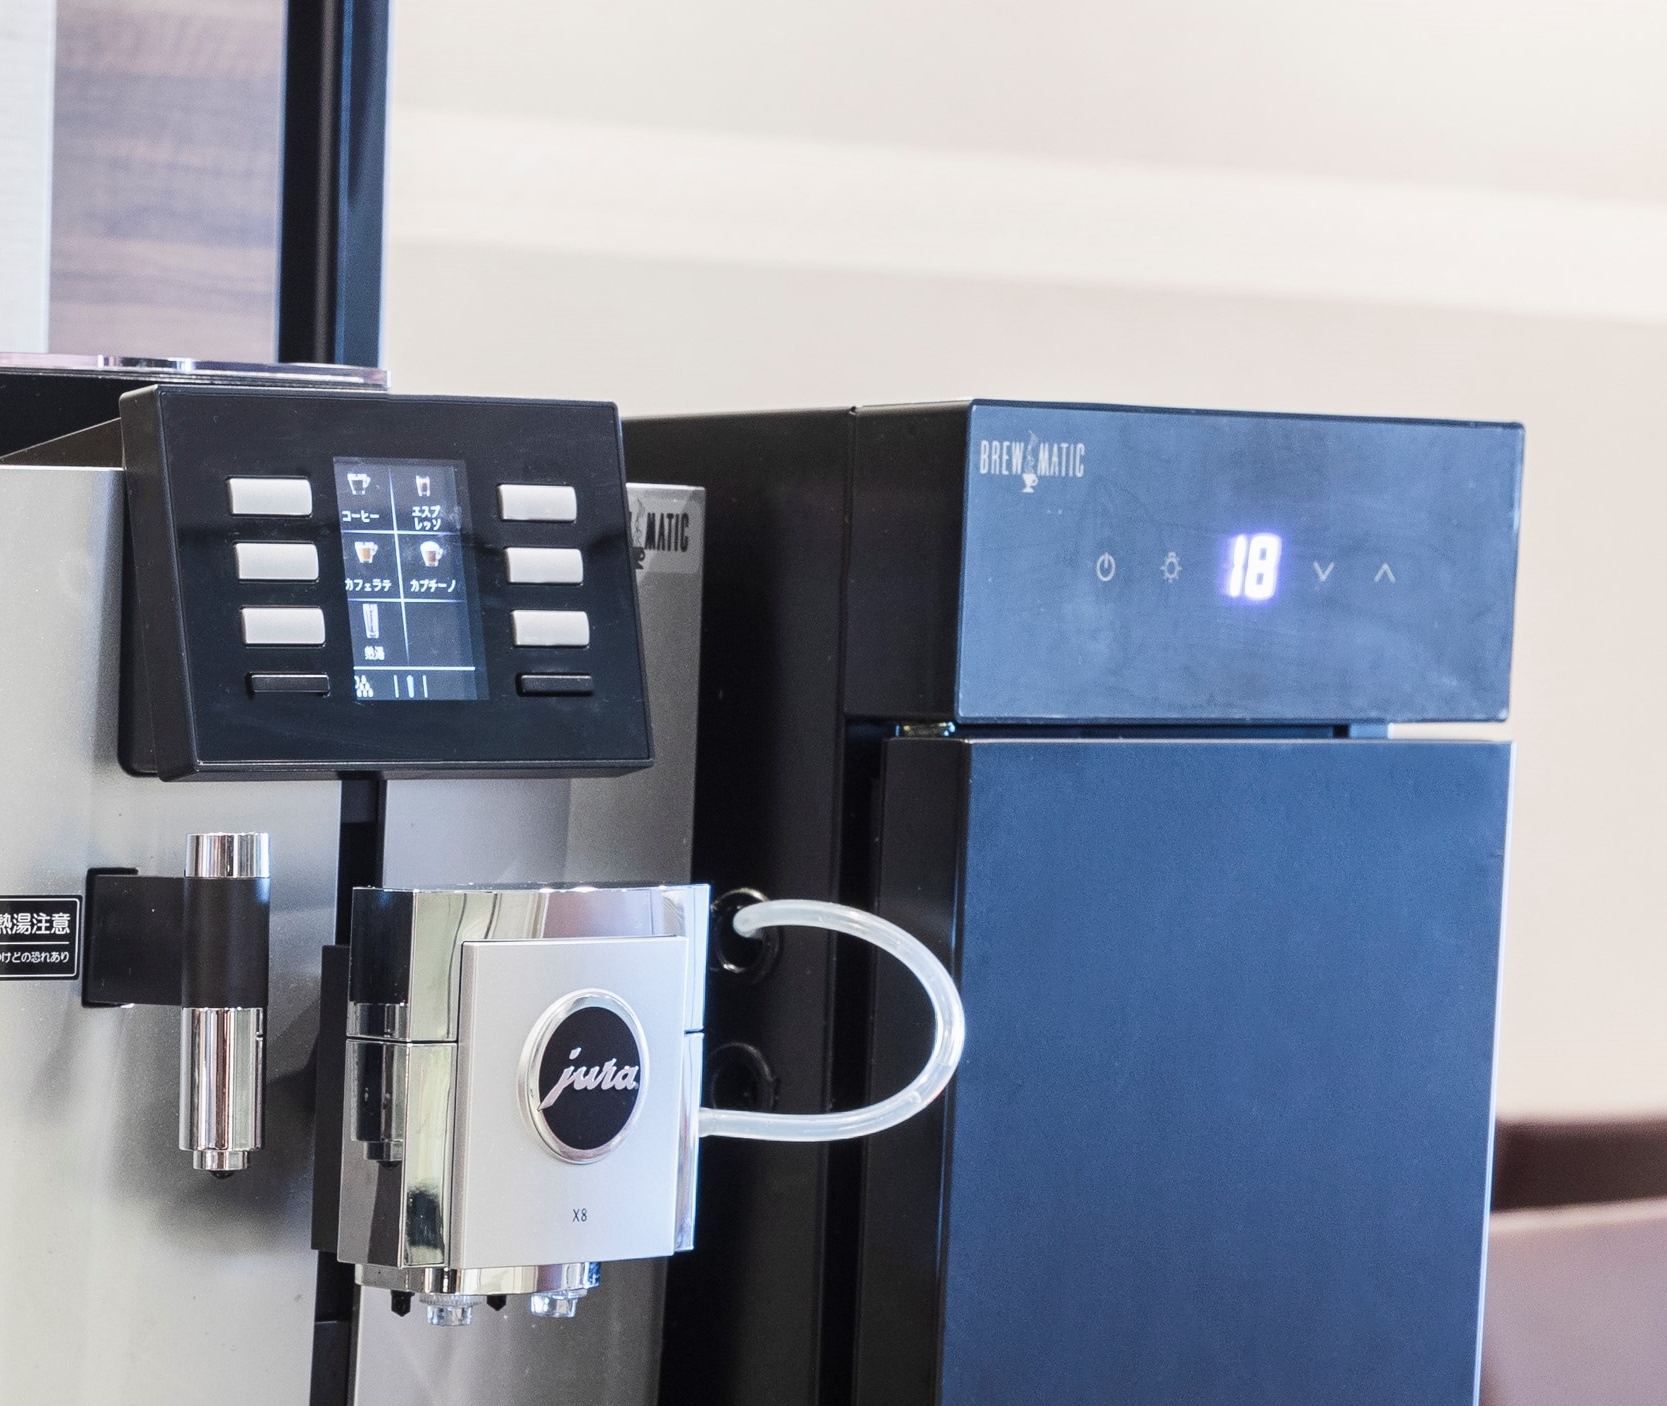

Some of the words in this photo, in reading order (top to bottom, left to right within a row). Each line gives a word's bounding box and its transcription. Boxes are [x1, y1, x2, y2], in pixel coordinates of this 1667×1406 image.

[979, 440, 1024, 475] BREW
[1037, 442, 1085, 478] MATIC
[341, 510, 380, 522] コーヒー
[411, 504, 441, 517] エスプ
[414, 517, 442, 530] レッソ
[645, 512, 689, 552] MATIC
[1228, 533, 1282, 600] 18
[345, 578, 392, 592] カフェラテ
[410, 579, 456, 593] カプチーノ
[537, 1046, 637, 1112] jura
[572, 1208, 588, 1223] X8
